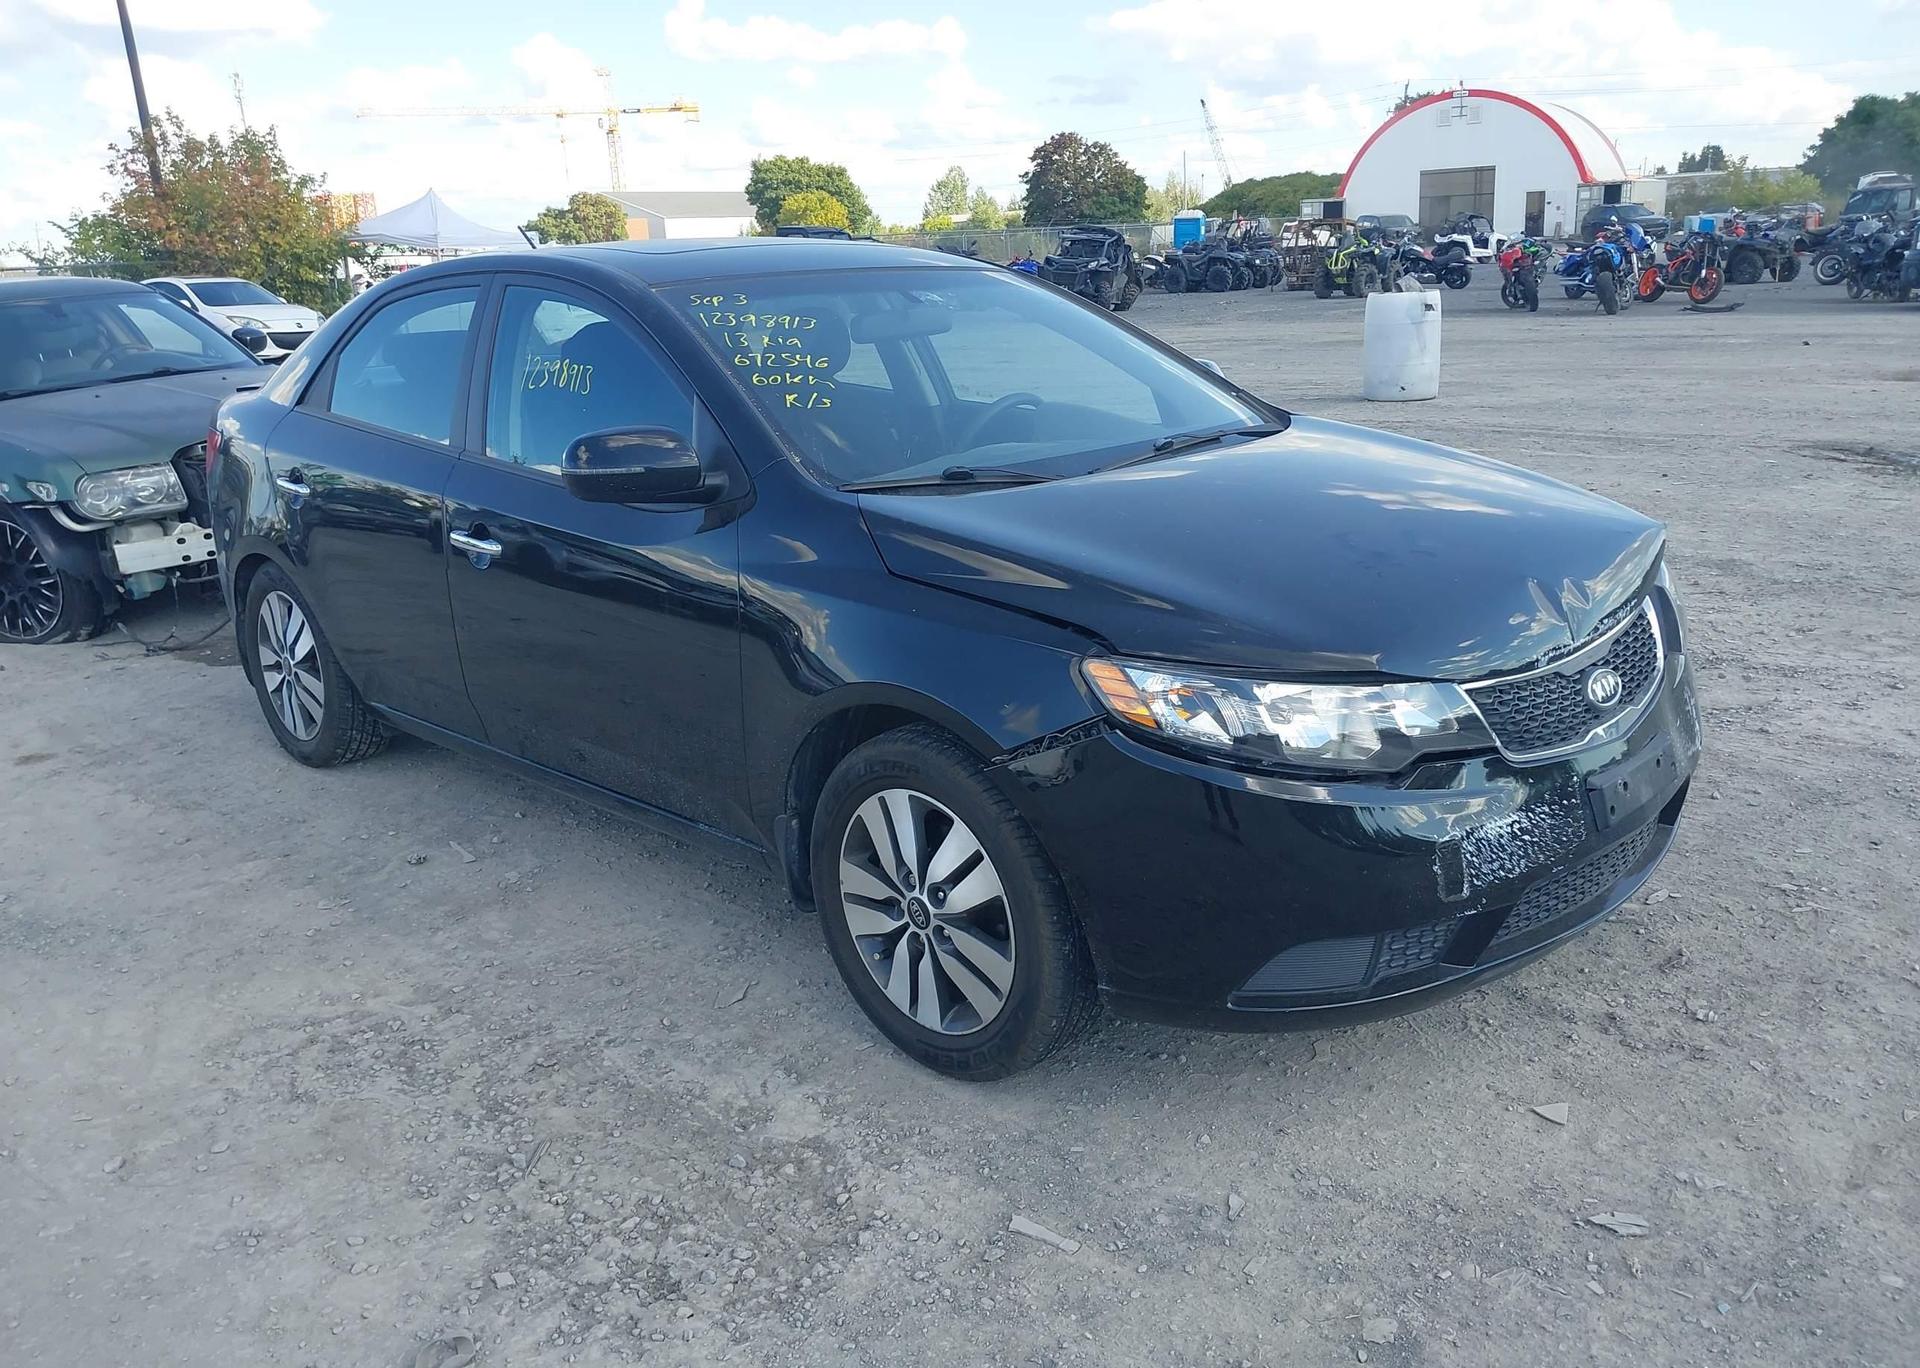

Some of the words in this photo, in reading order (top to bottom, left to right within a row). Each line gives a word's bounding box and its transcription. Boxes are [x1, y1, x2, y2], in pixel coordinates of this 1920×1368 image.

[734, 294, 748, 305] 3
[700, 312, 816, 329] 12398913
[724, 332, 748, 348] 13
[735, 354, 829, 368] 672546
[521, 353, 593, 393] 12398913
